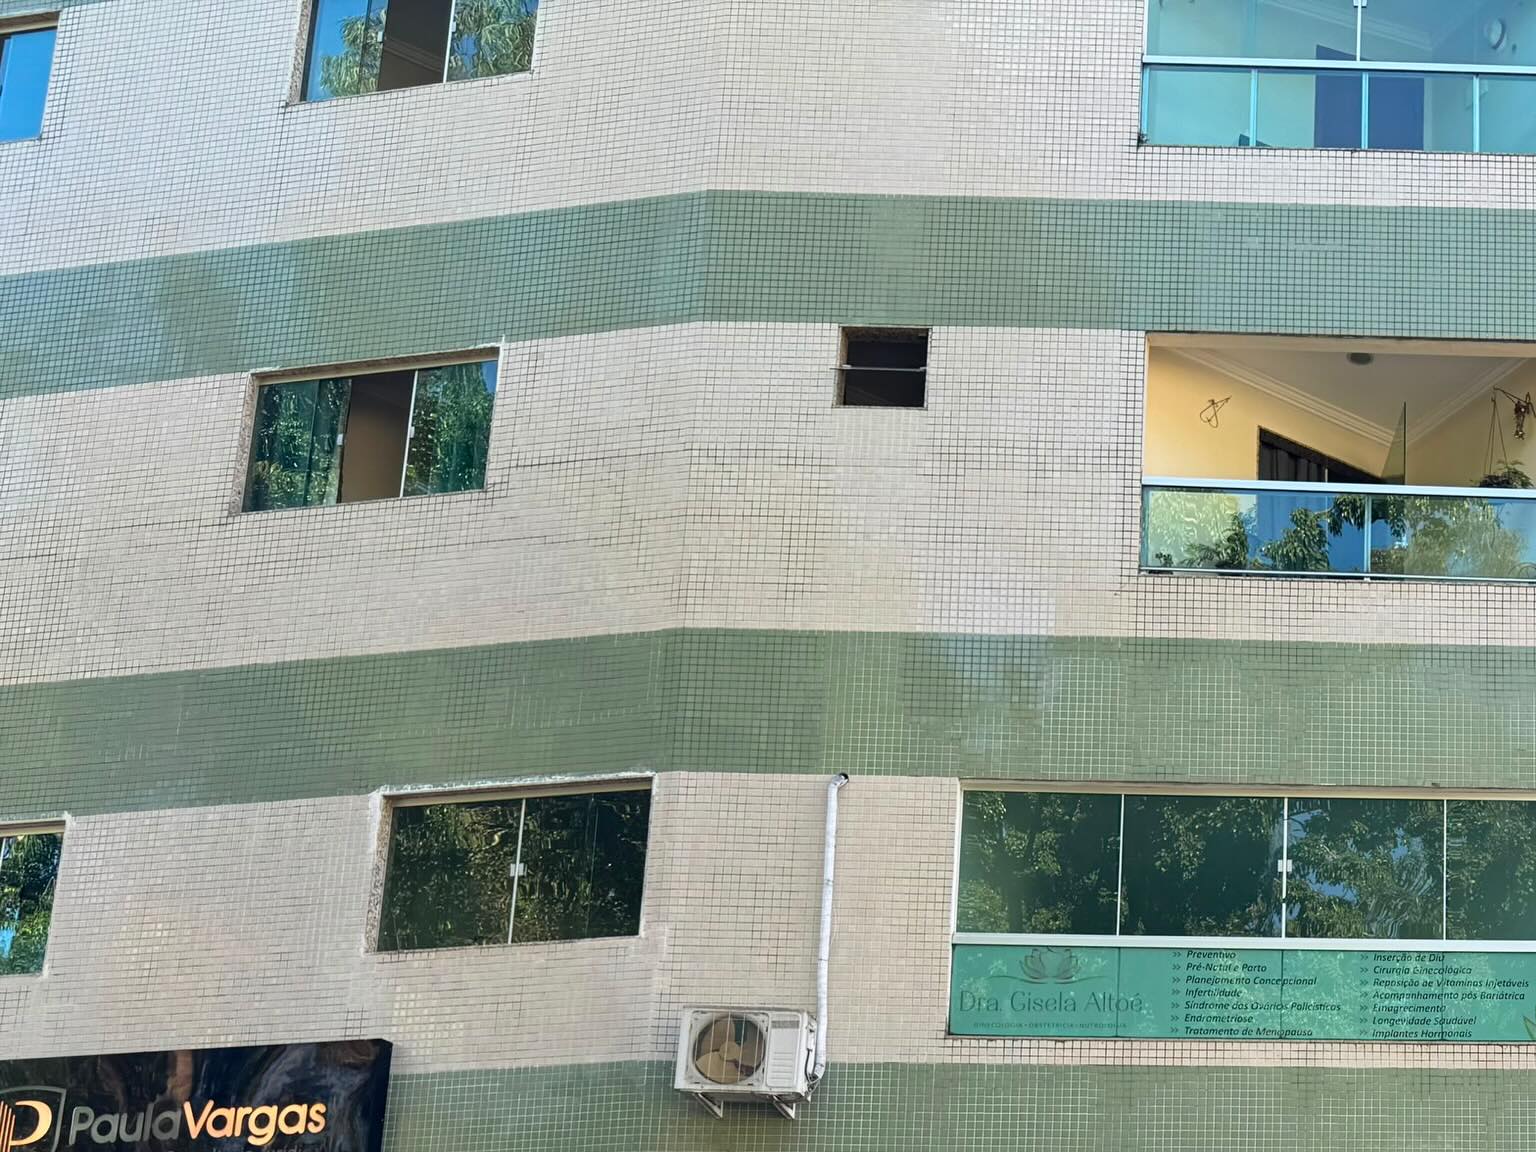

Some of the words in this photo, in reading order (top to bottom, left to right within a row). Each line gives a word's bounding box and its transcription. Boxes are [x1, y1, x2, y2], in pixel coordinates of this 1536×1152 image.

[1414, 953, 1426, 963] de
[1241, 964, 1268, 973] Parto
[959, 990, 1002, 1013] Dra.
[1010, 990, 1076, 1013] Gisela
